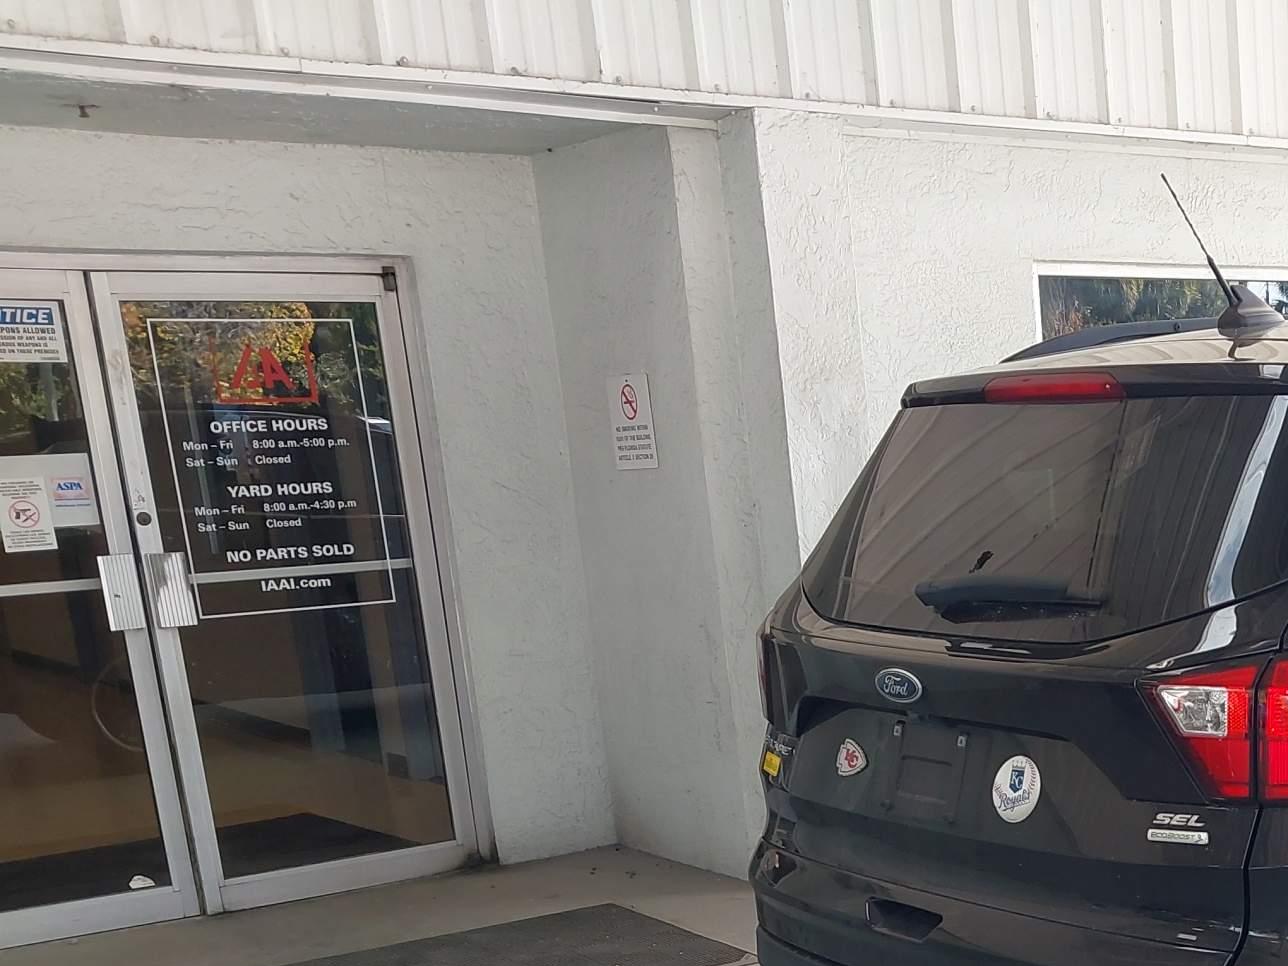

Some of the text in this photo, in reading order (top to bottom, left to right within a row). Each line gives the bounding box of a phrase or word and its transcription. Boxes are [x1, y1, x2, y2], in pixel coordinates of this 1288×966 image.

[22, 327, 56, 335] ALLOWED
[210, 418, 329, 434] OFFICE HOURS
[182, 441, 209, 451] Mon
[219, 440, 234, 450] Fri
[252, 439, 276, 449] 8:00
[278, 438, 326, 449] a.m.-5:00
[327, 438, 350, 449] p.m.
[185, 457, 206, 468] Sat
[216, 456, 239, 466] Sun
[255, 454, 292, 465] Closed
[56, 481, 84, 491] ASPA
[227, 482, 333, 498] YARD HOURS
[194, 506, 220, 517] Mon
[231, 504, 246, 515] Fri
[263, 502, 287, 513] 8:00
[288, 500, 336, 511] a.m.-4:30
[197, 523, 218, 532] Sat
[227, 521, 250, 531] Sun
[266, 518, 302, 529] Closed
[226, 544, 355, 563] NO PARTS SOLD
[261, 577, 332, 592] IAAI.com
[998, 788, 1031, 812] Royals
[1152, 813, 1206, 827] SEL
